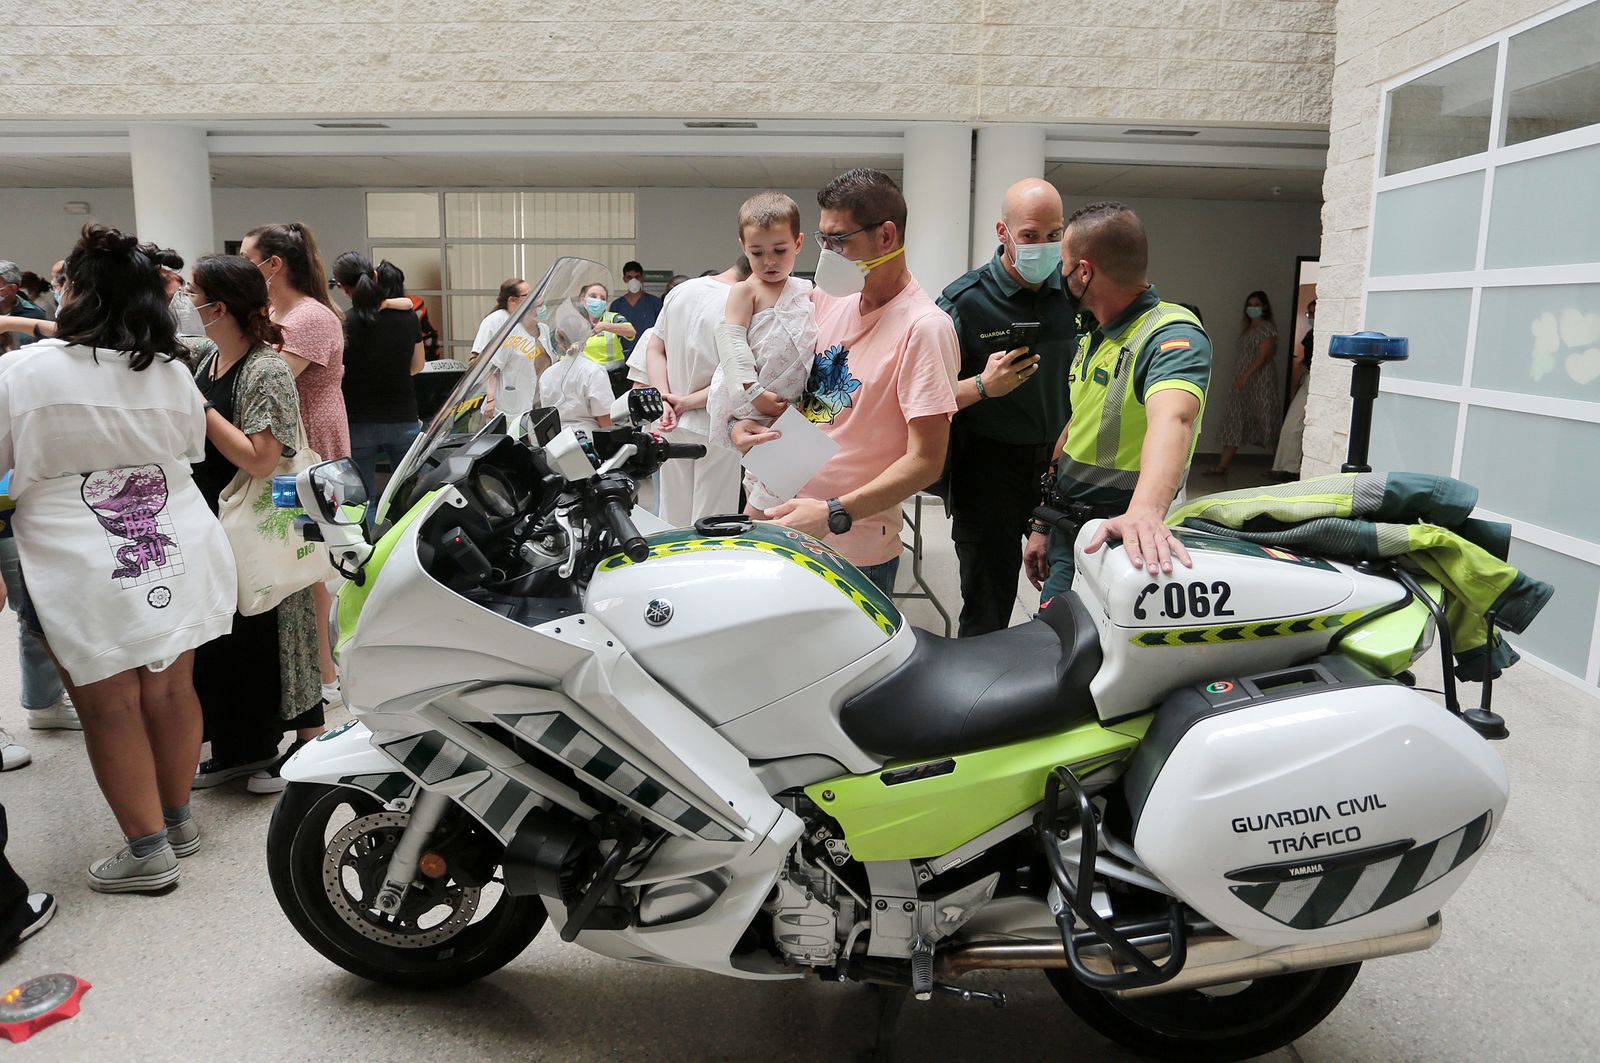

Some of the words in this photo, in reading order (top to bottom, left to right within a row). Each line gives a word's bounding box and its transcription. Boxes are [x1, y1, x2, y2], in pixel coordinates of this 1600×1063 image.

[980, 331, 1005, 339] GUARDIA
[1231, 804, 1331, 834] GUARDIA
[1336, 793, 1387, 817] CIVIL
[1268, 825, 1362, 855] TRÁFICO
[1288, 863, 1325, 877] YAMAHA
